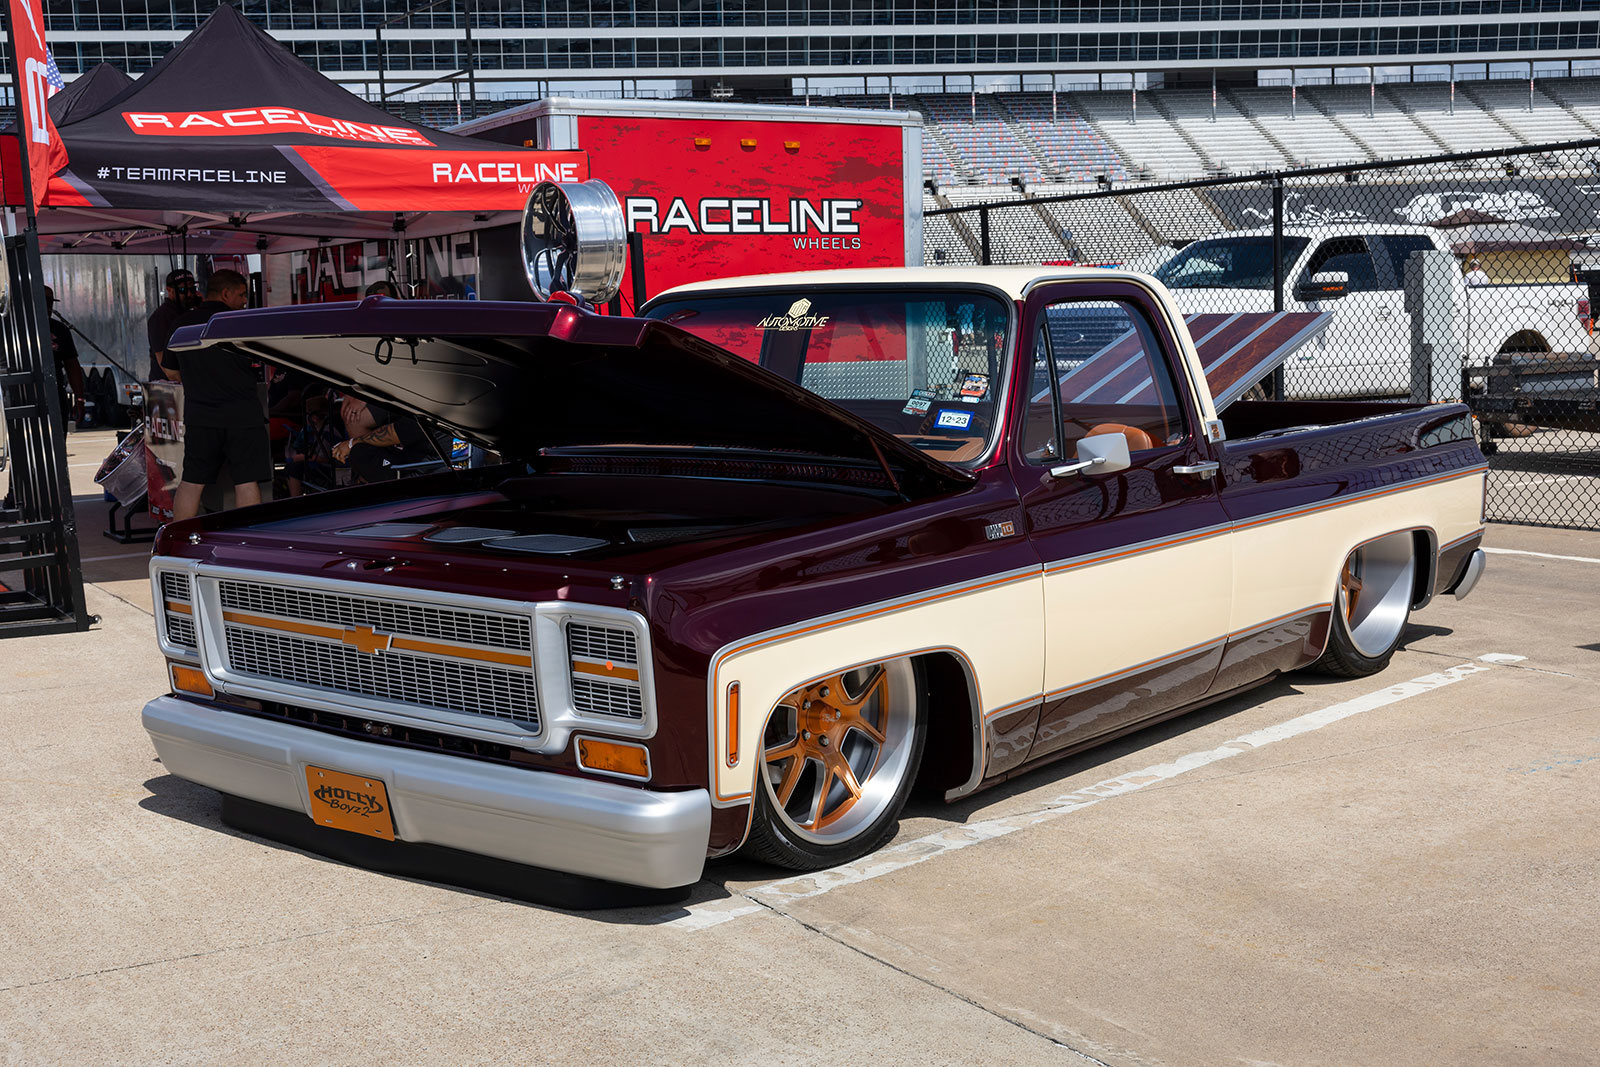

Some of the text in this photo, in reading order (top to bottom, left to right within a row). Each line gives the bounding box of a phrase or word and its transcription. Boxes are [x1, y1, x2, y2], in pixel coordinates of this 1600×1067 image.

[129, 108, 422, 141] RACELINE
[309, 127, 430, 146] WHEELS
[97, 166, 287, 184] #TEAMRACELINE
[432, 163, 579, 183] RACELINE
[626, 196, 861, 234] RACELINE
[793, 236, 862, 251] WHEELS
[756, 312, 830, 327] AUTOMOTIVE
